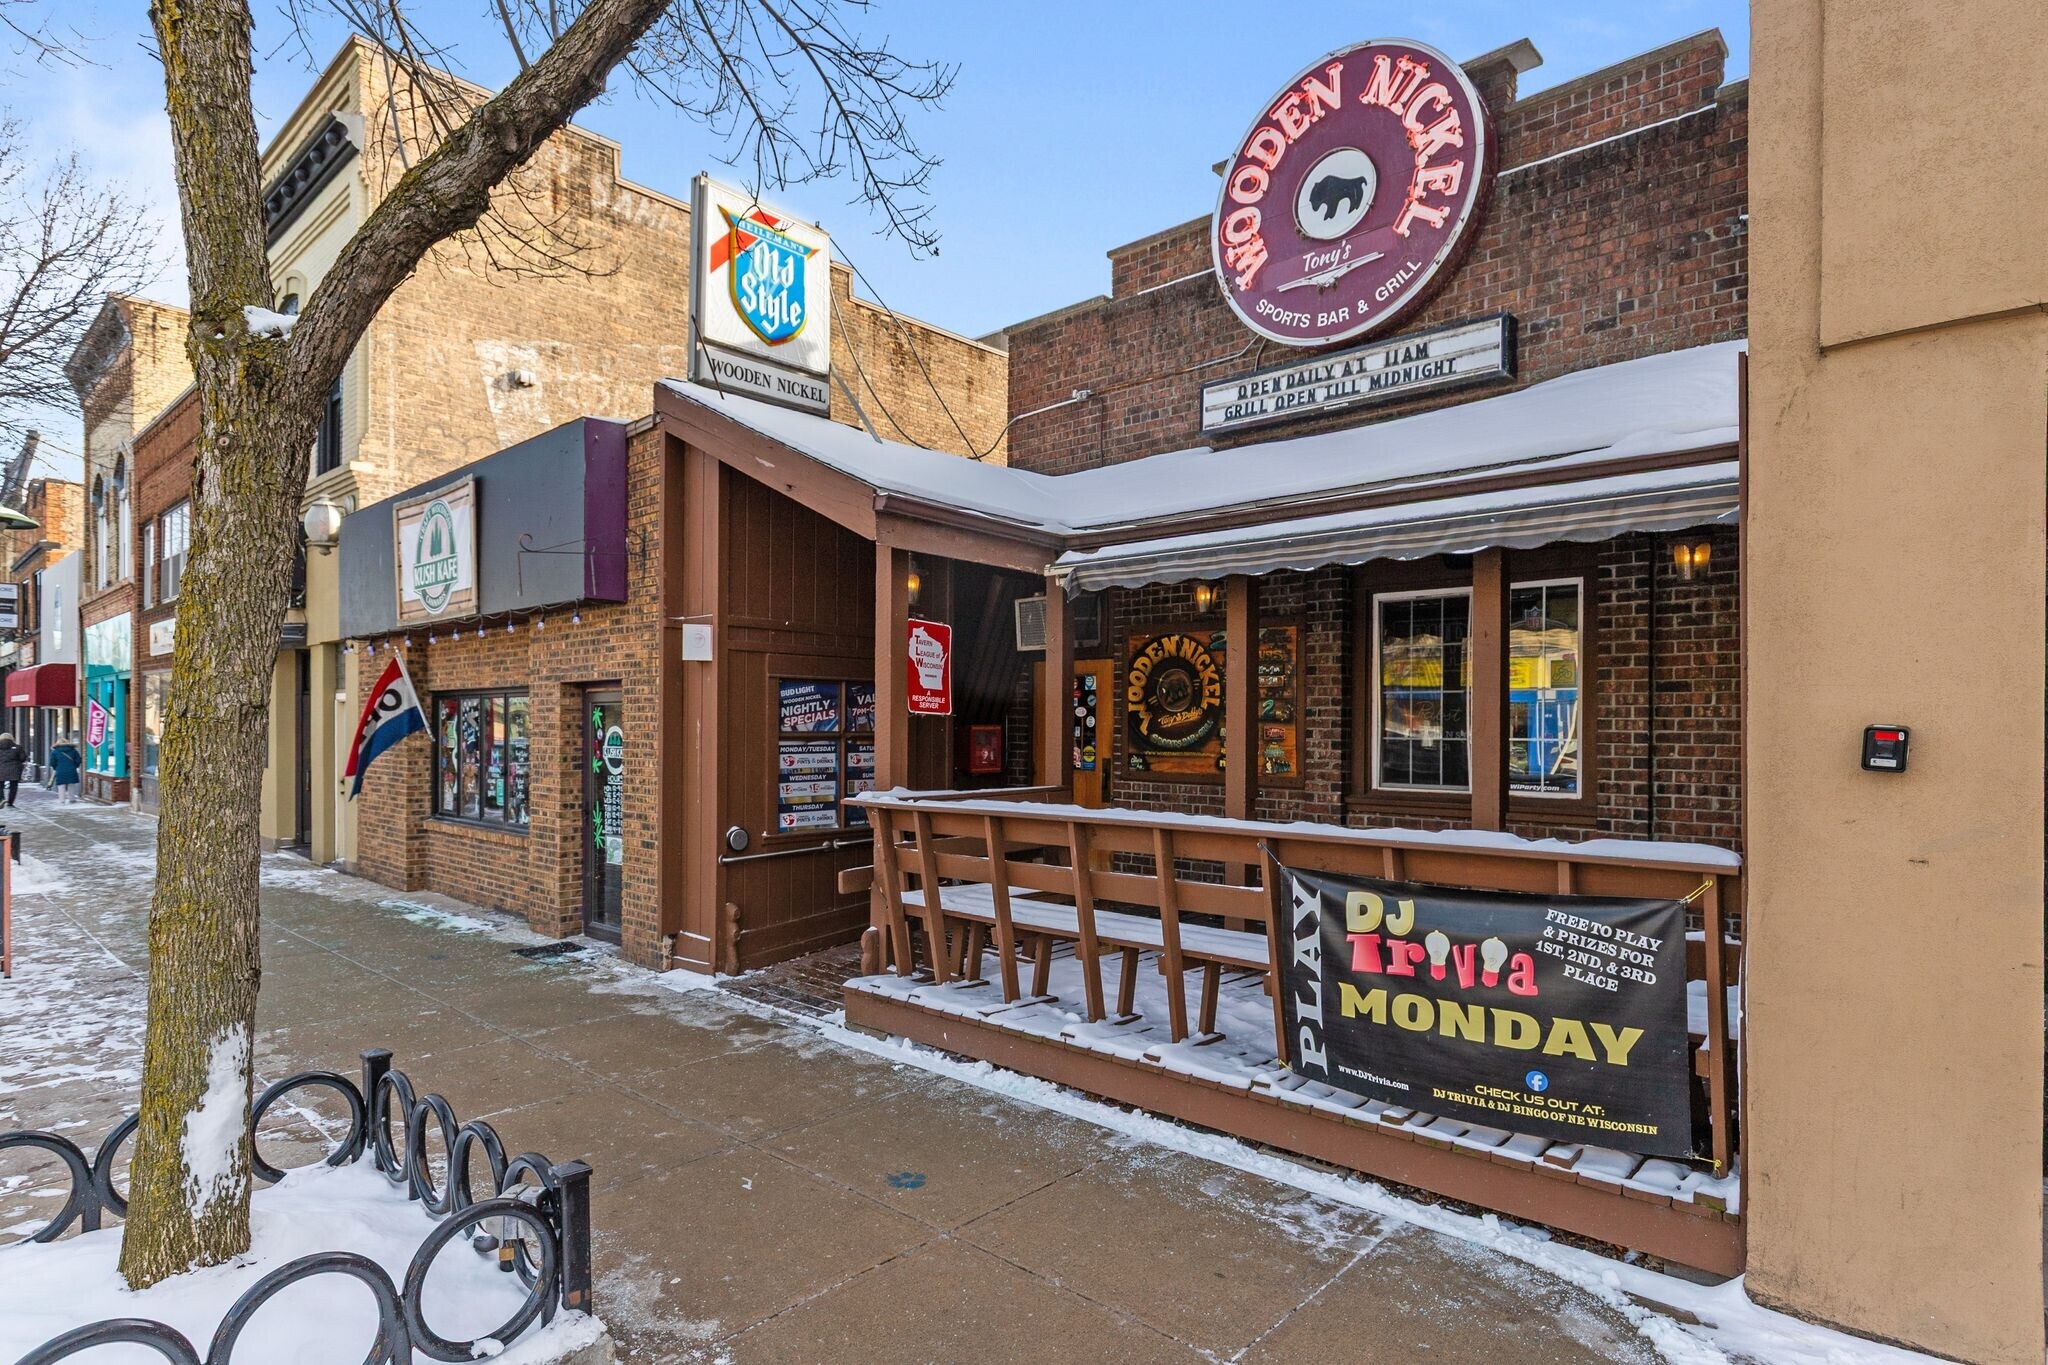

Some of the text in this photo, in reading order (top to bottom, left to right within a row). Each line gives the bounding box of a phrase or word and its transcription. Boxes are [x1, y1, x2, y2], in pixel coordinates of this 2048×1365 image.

[1219, 54, 1464, 291] WOODEN NICKEL
[739, 219, 805, 254] HEILEMAN'S
[753, 241, 795, 289] Old
[1302, 239, 1352, 271] Tony's
[741, 272, 802, 334] Style
[1255, 259, 1422, 328] SPORTS BAR & GRILL
[711, 358, 826, 403] WOODEN NICKEL
[1224, 358, 1457, 421] GRILL OPEN TILL MIDNIGHT
[1237, 377, 1281, 400] OPEN
[1286, 364, 1336, 390] DAILY
[1341, 357, 1367, 377] AT
[414, 558, 457, 587] KUSH KAFE
[915, 635, 933, 646] TAVERN
[916, 646, 936, 658] LEAGUE
[916, 657, 943, 670] WISCONSIN
[1180, 637, 1220, 710] NICKEL
[780, 685, 815, 697] BUD LIGHT
[781, 700, 831, 717] NIGHTLY
[912, 695, 945, 704] RESPONSIBLE
[90, 710, 105, 743] OPEN
[783, 709, 836, 727] SPECIALS
[780, 745, 836, 753] MONDAY/TUESDAY
[1510, 783, 1560, 791] WiPartycom
[792, 803, 824, 811] THURSDAY
[1345, 891, 1415, 936] DJ
[1545, 908, 1663, 952] FREE TO PLAY
[1346, 930, 1539, 996] Trivia
[1535, 940, 1657, 985] 1ST, 2ND, & 3RD
[1543, 925, 1655, 968] & PRIZES FOR
[1292, 875, 1329, 1075] PLAY
[1562, 964, 1619, 992] PLACE
[1338, 981, 1645, 1067] MONDAY
[1338, 1065, 1410, 1091] www.DJTrivia.com
[1432, 1088, 1658, 1135] DJ TRIVIA & DJ BINGO OF NE WISCONSIN
[1474, 1085, 1605, 1116] CHECK US OUT AT:
